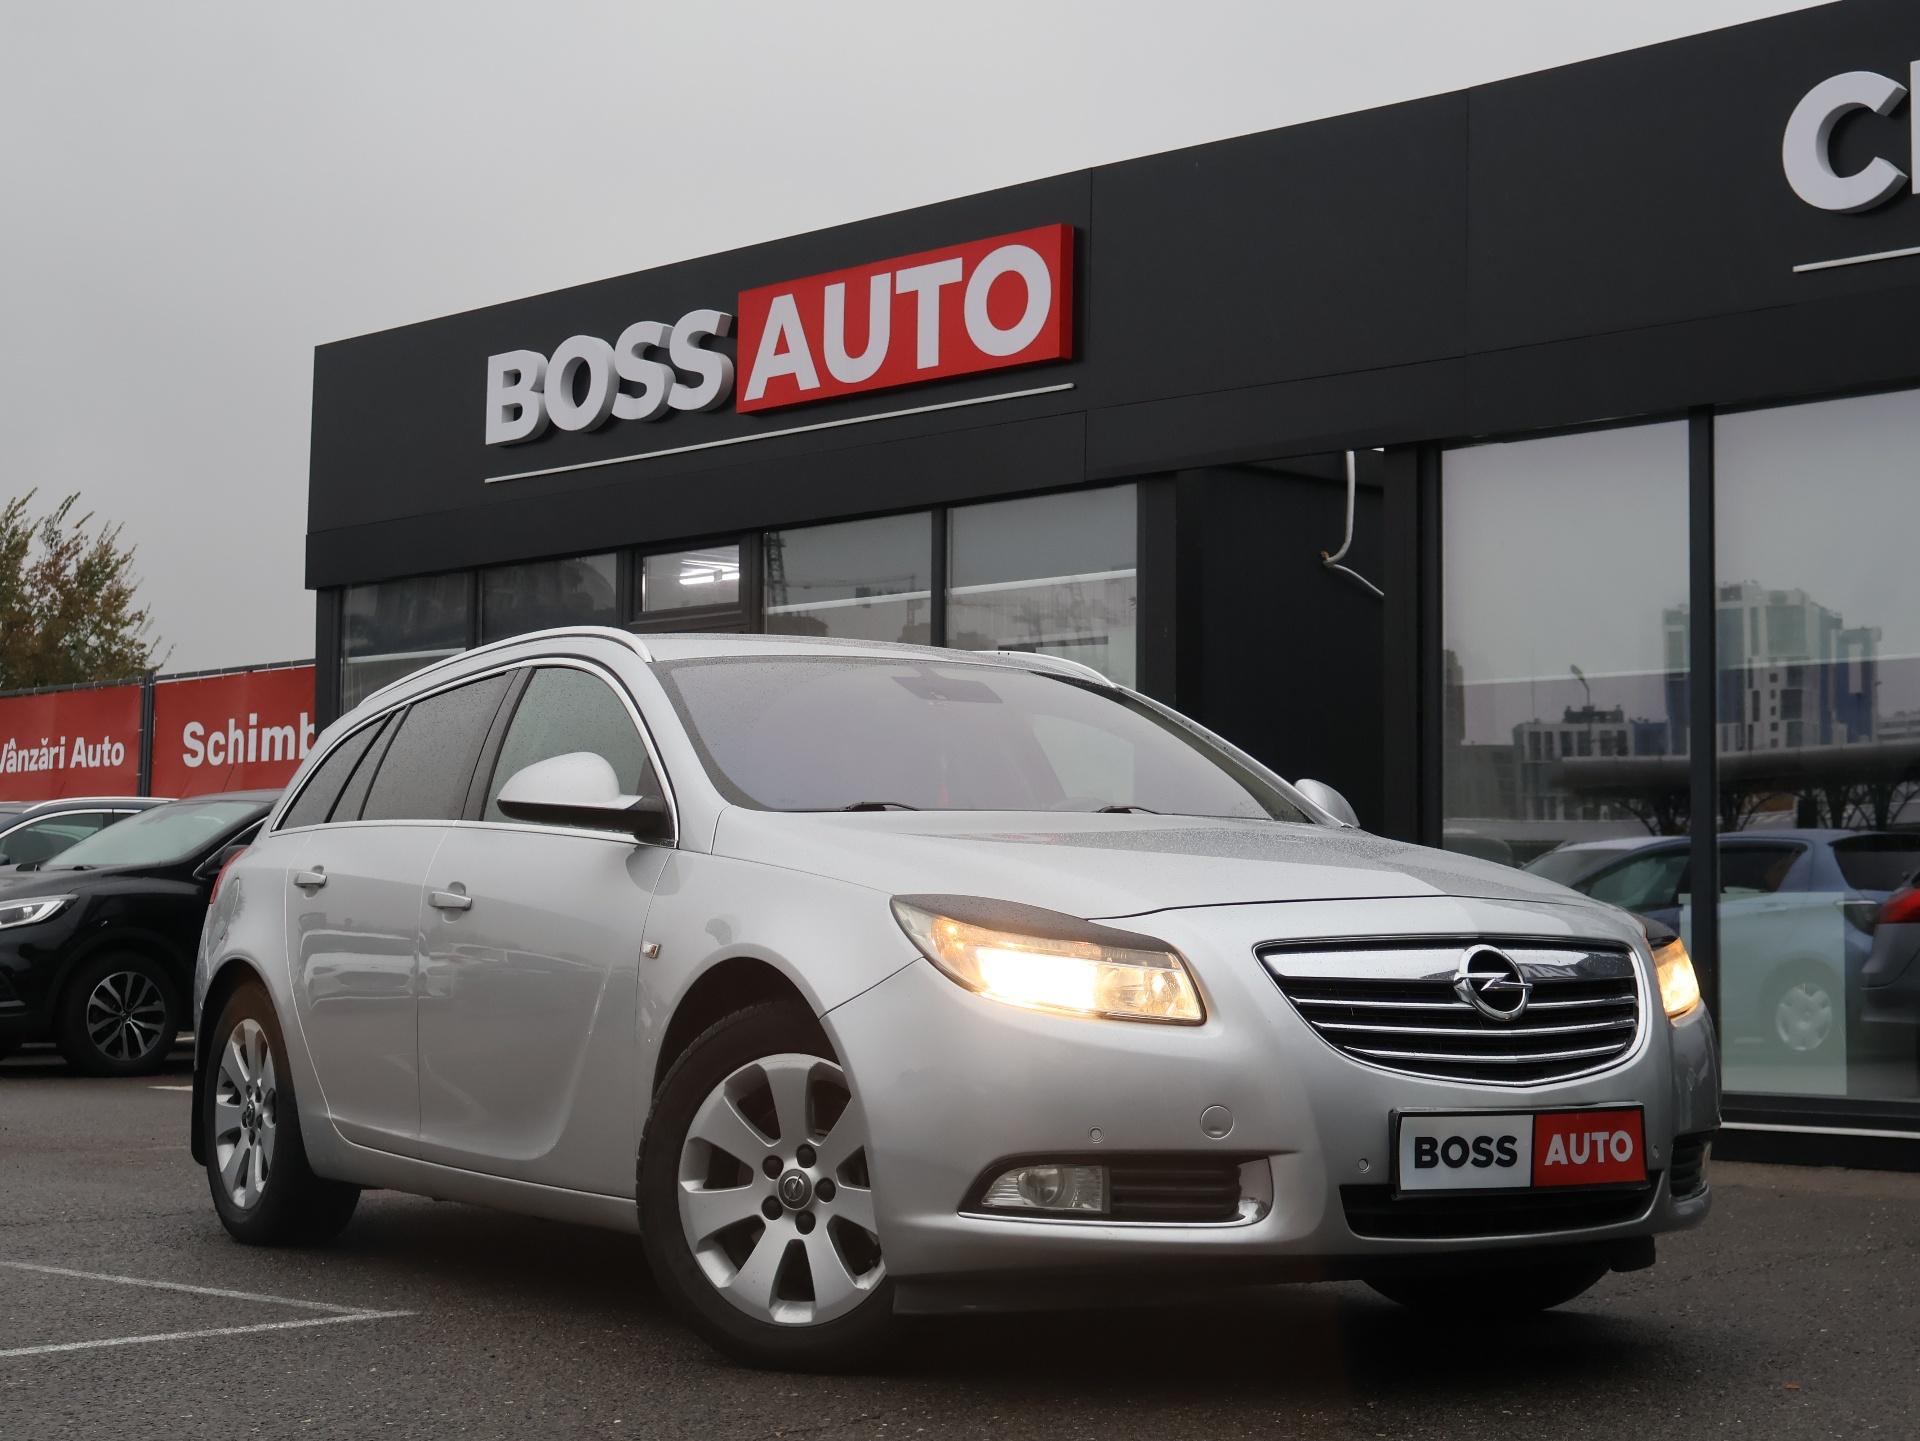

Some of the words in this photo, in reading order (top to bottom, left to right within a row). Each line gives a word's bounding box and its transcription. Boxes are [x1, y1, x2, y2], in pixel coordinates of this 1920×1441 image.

[1782, 59, 1920, 214] C
[485, 309, 735, 446] BOSS
[743, 244, 1052, 402] AUTO
[69, 735, 125, 769] Auto
[182, 711, 315, 768] Schimb
[1414, 1135, 1518, 1169] BOSS
[1544, 1130, 1633, 1166] AUTO
